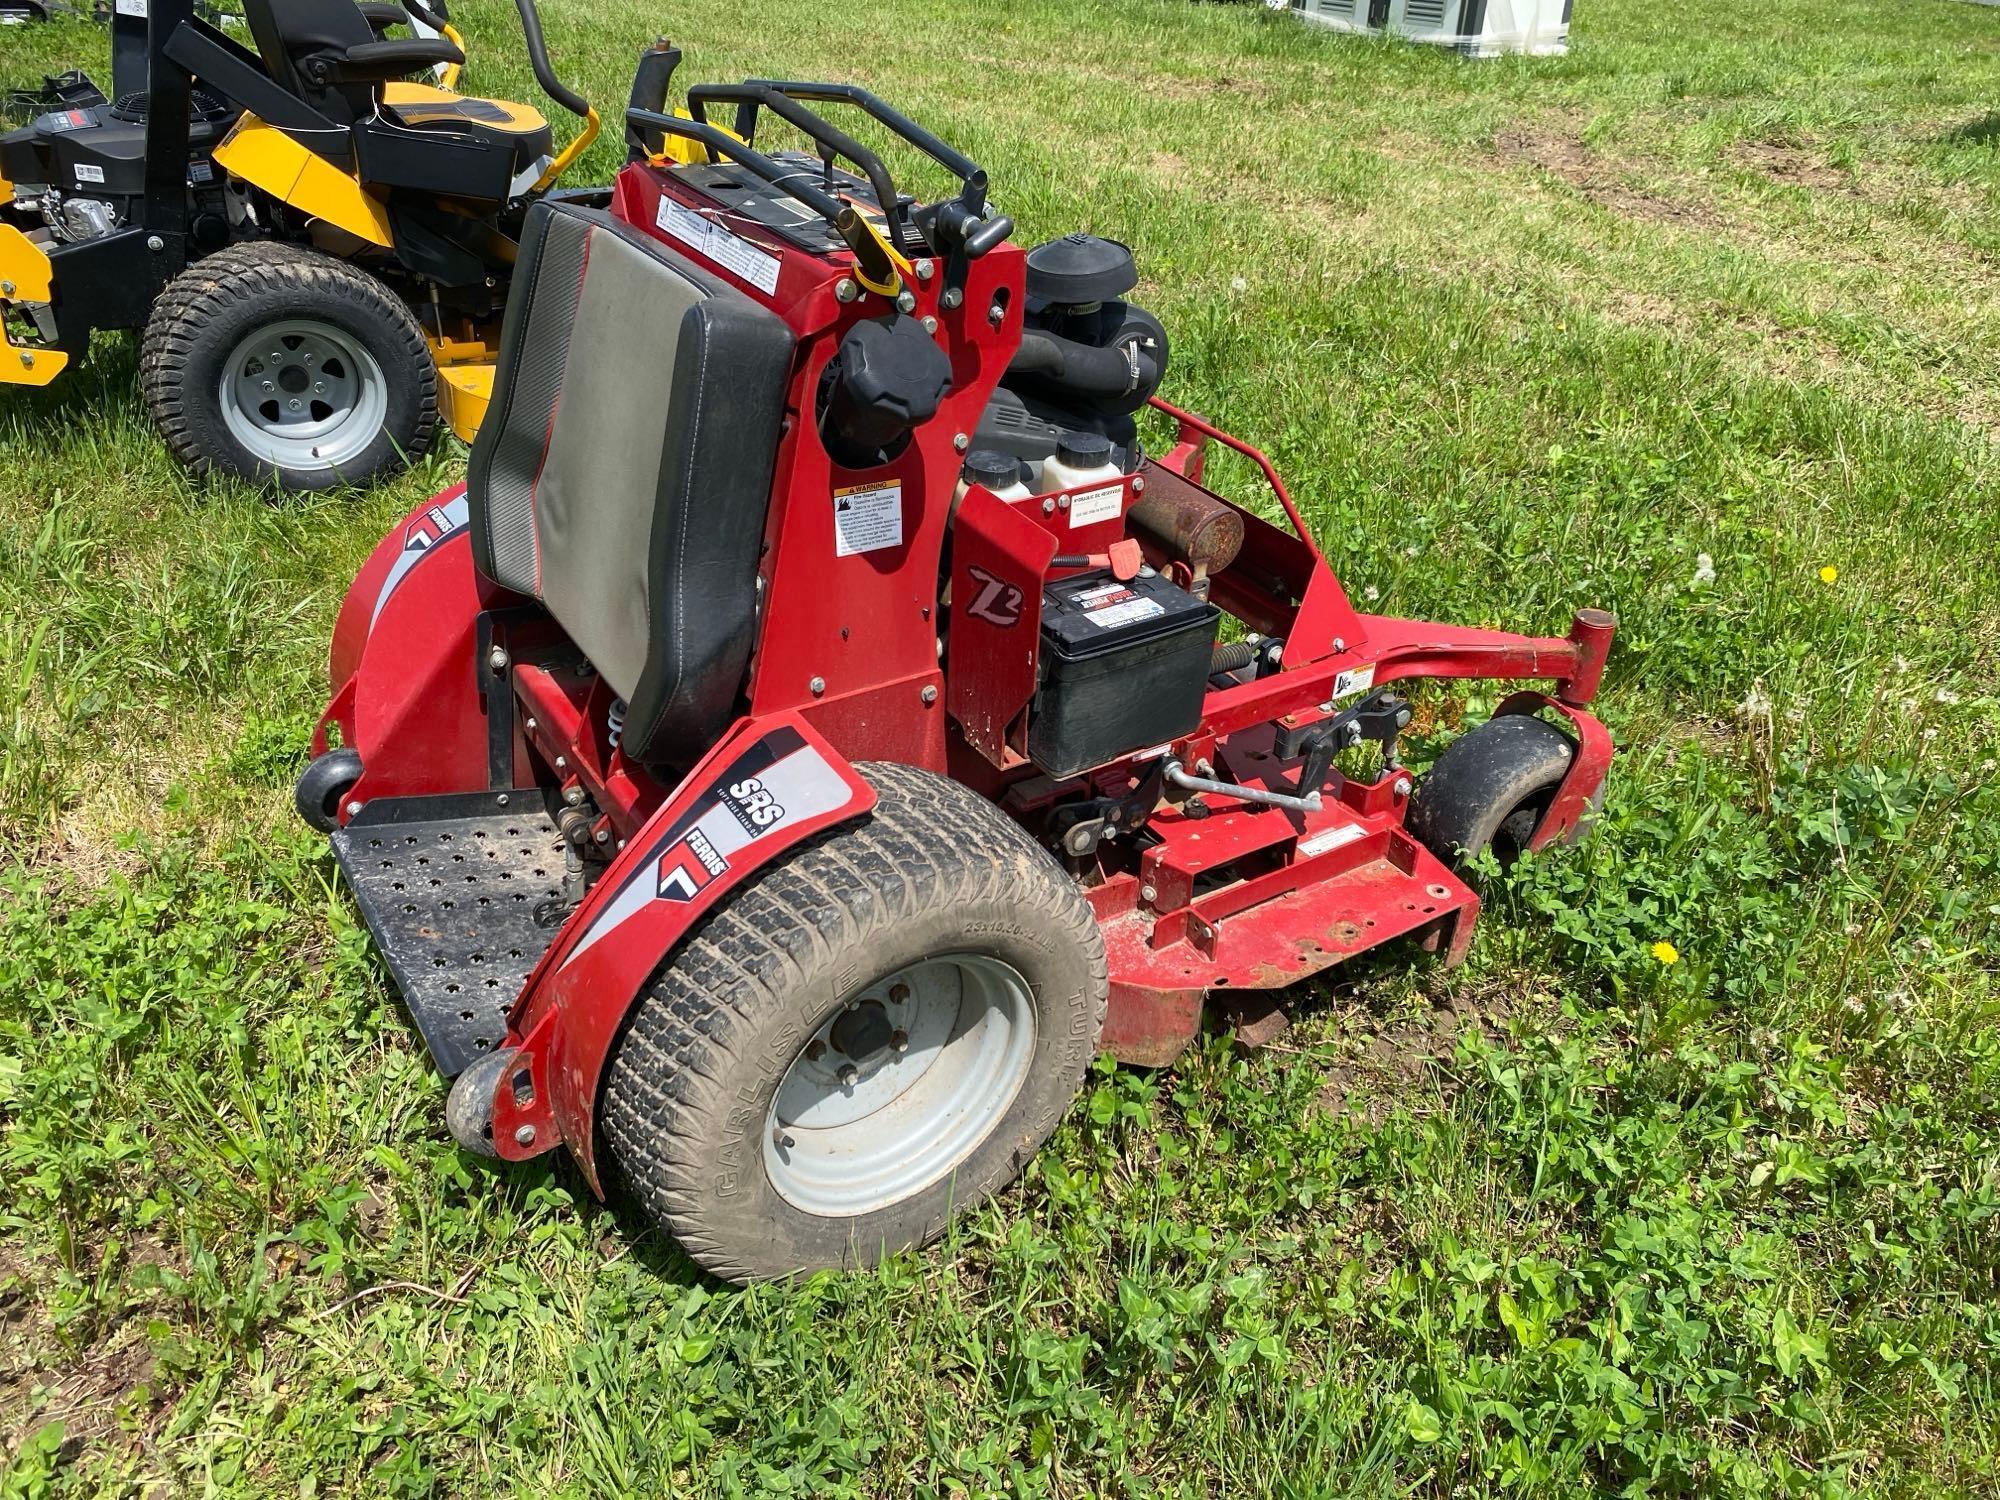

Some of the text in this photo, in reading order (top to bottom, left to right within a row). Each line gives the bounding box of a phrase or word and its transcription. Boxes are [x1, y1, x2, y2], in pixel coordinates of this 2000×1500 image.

[855, 482, 887, 492] WARNING
[428, 507, 451, 533] FERRIS
[717, 788, 758, 837] SOFT RIDE STAND-ON
[729, 778, 785, 825] SRS
[686, 829, 726, 876] FERRIS
[1058, 987, 1088, 1087] TURF
[715, 962, 860, 1197] CARLISLE
